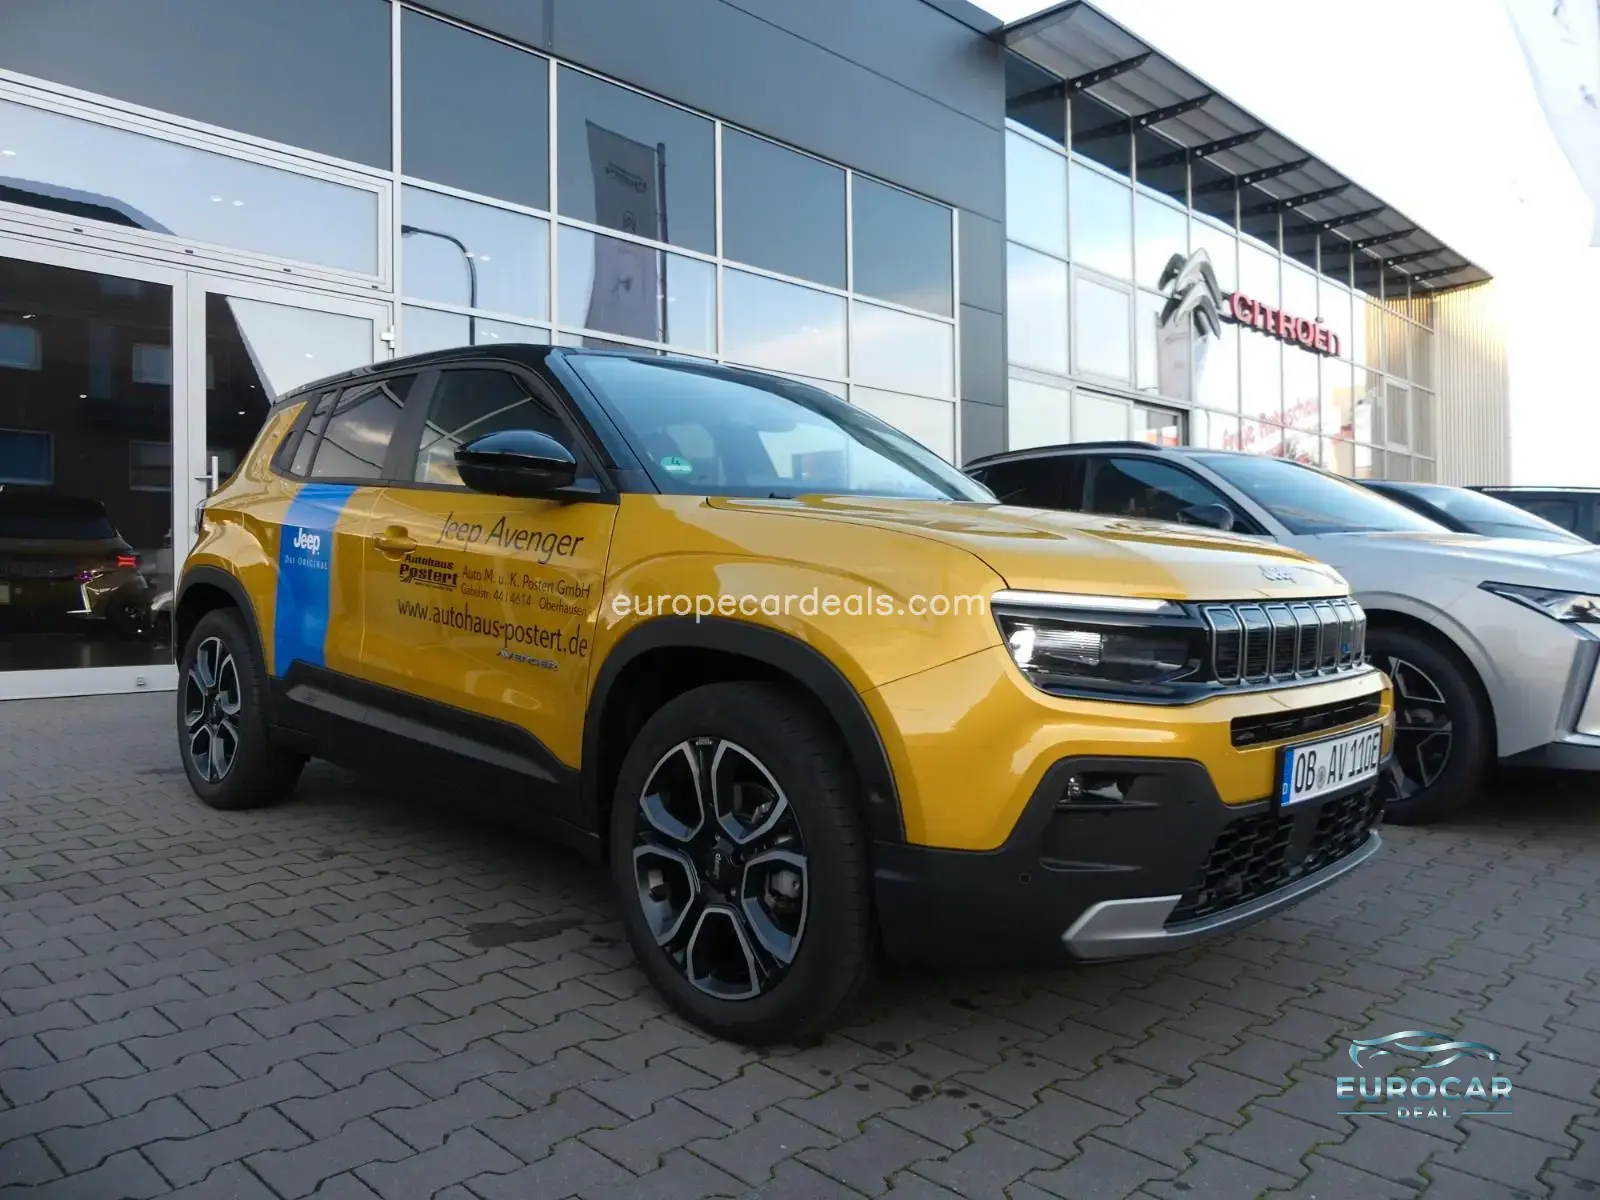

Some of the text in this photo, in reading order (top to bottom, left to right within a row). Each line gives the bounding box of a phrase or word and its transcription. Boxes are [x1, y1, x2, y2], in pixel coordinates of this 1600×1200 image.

[293, 527, 321, 555] Jeep
[436, 511, 585, 565] Jeep Avenger
[400, 563, 458, 586] Postert
[404, 553, 455, 571] Autohaus
[461, 565, 481, 582] Auto
[557, 579, 591, 599] GmbH
[538, 597, 587, 617] Oberhausen
[398, 599, 589, 658] www.autohaus-postert.de
[1294, 750, 1317, 793] OB
